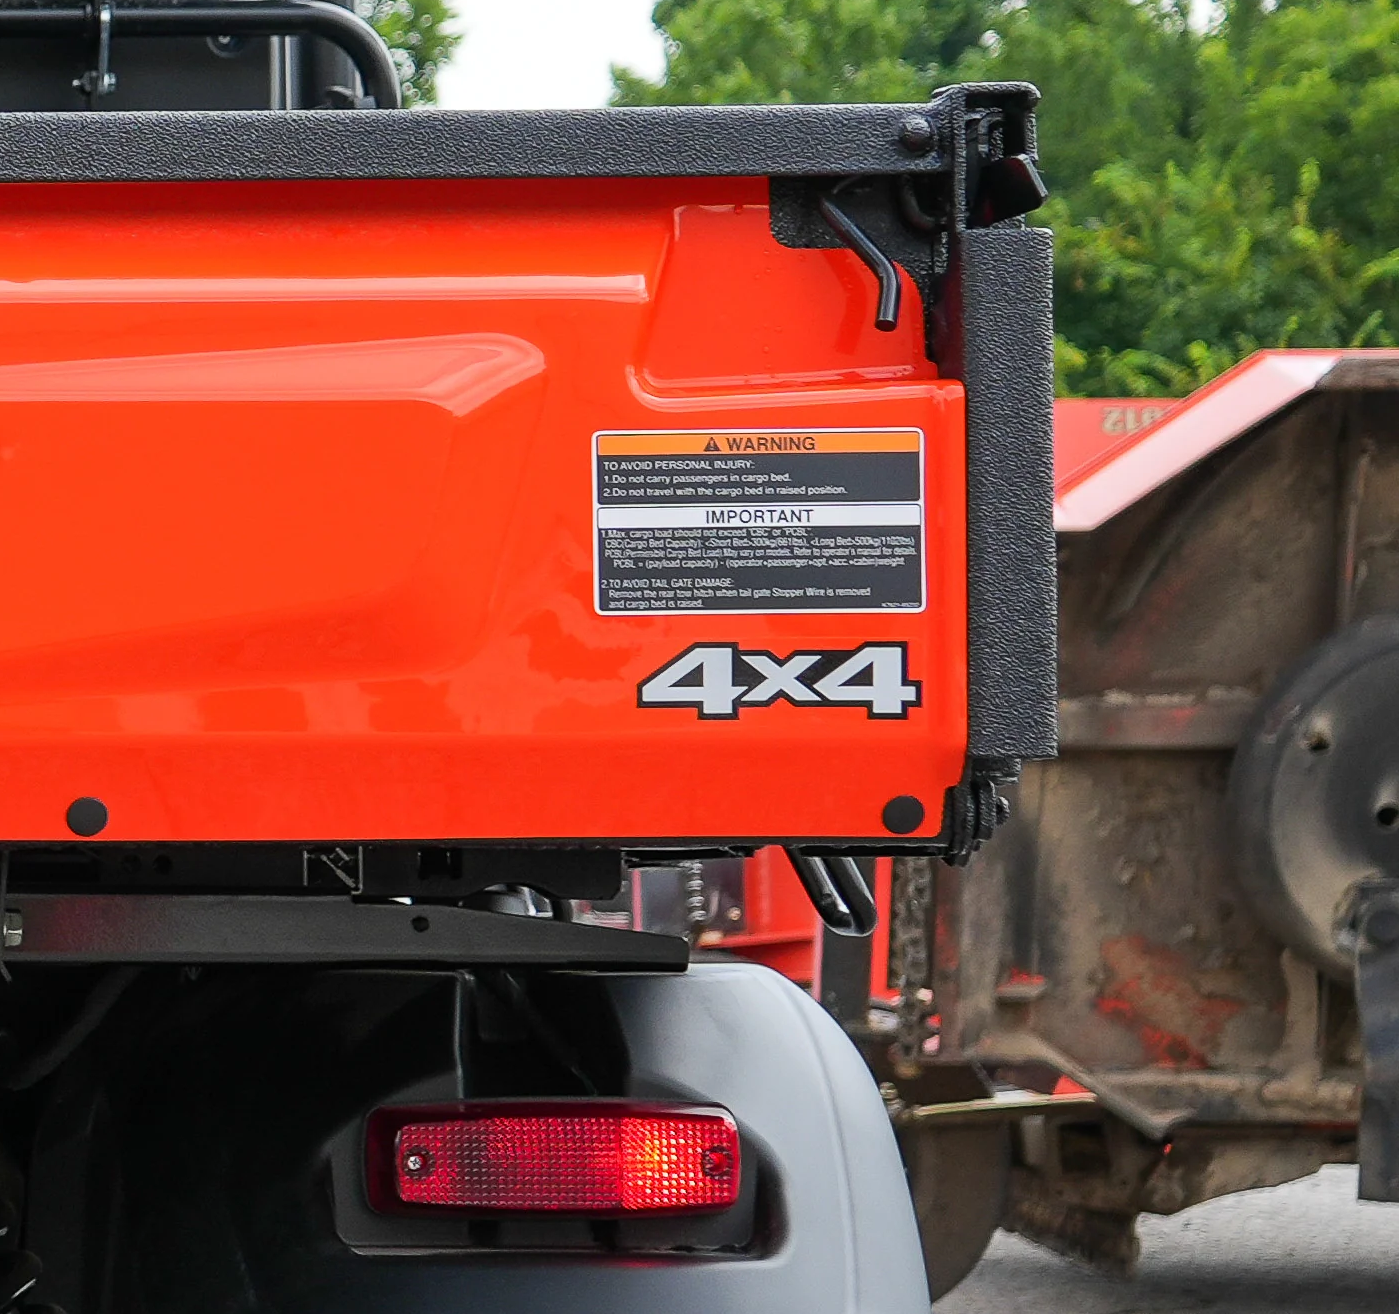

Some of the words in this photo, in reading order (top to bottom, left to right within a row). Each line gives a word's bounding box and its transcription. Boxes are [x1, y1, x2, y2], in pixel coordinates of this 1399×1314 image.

[726, 437, 816, 451] WARNING
[603, 461, 618, 470] TO
[620, 461, 652, 470] AVOID
[654, 461, 711, 470] PERSONAL
[713, 460, 755, 469] INJURY:
[604, 475, 626, 483] 1.Do
[628, 475, 644, 483] not
[645, 476, 670, 485] carry
[672, 476, 728, 485] passengers
[729, 474, 739, 482] in
[741, 475, 768, 484] cargo
[770, 473, 791, 482] bed.
[603, 488, 627, 497] 2.Do
[628, 488, 644, 496] not
[646, 488, 673, 496] travel
[675, 488, 695, 496] with
[697, 487, 713, 495] the
[714, 489, 742, 497] cargo
[744, 487, 763, 495] bed
[764, 487, 774, 495] in
[776, 486, 805, 495] raised
[807, 486, 847, 496] position.
[705, 509, 814, 524] IMPORTANT
[639, 644, 919, 717] 4x4
